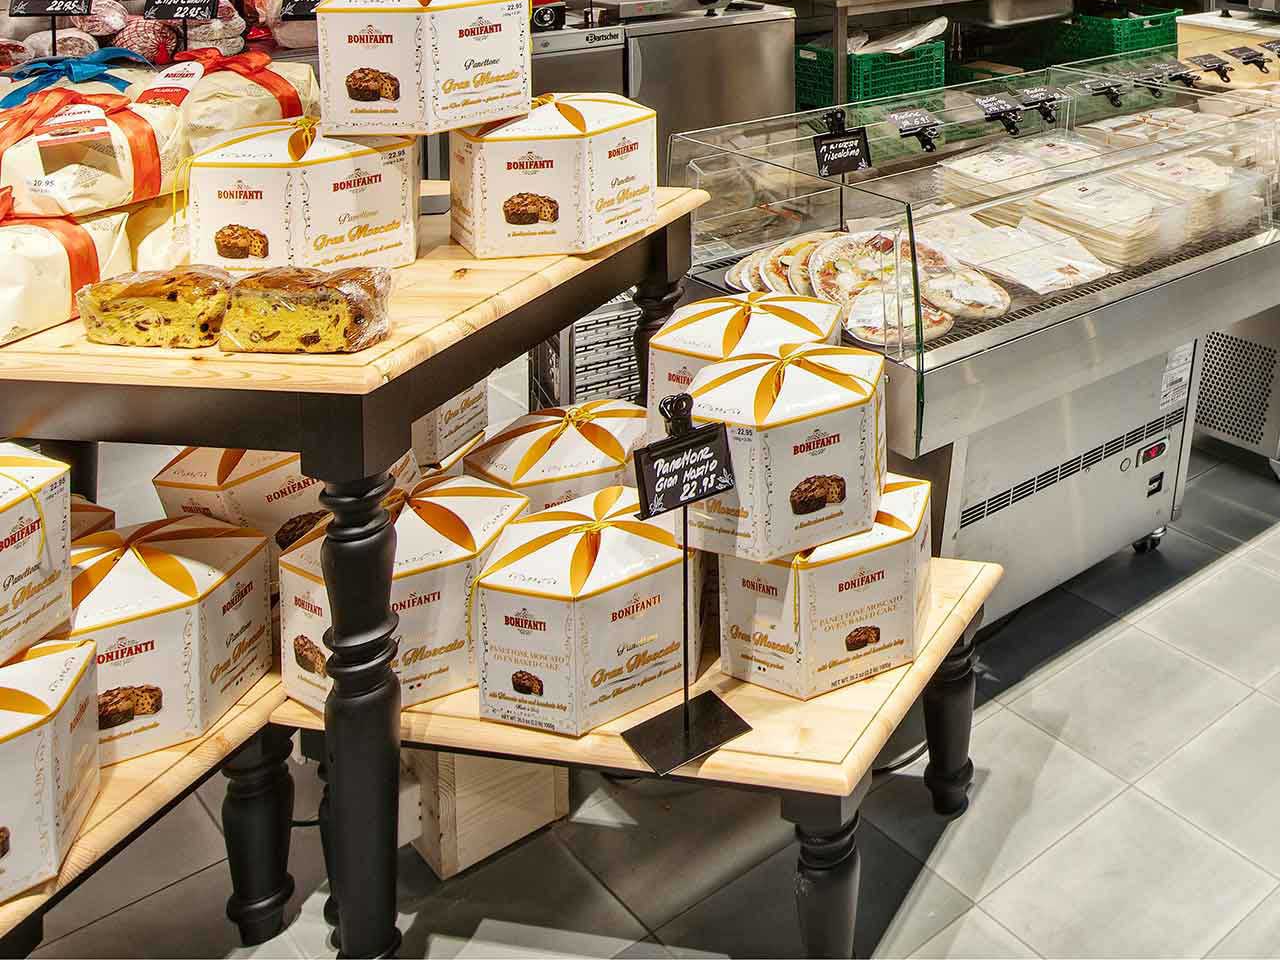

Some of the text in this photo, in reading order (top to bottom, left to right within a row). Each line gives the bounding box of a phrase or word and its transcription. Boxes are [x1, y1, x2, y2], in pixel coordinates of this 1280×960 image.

[347, 34, 393, 44] BONIFANTI
[458, 23, 502, 38] BONIFANTI
[464, 57, 501, 70] Panettone
[607, 142, 639, 159] BONIFANTI
[506, 159, 554, 171] BONIFANTI
[333, 174, 382, 192] BONIFANTI
[217, 190, 263, 200] BONIFANTI
[668, 371, 693, 386] BONIFA
[737, 428, 753, 436] 22.95
[793, 433, 840, 455] BONIFANTI
[266, 478, 318, 503] BONIFANT
[0, 519, 42, 551] BONIFANT
[742, 578, 778, 597] BONIFANTI
[838, 570, 885, 592] BONIFANTI
[222, 580, 254, 616] BONIFANTI
[294, 596, 323, 617] BONIFANTI
[392, 591, 441, 612] ONIFANTI
[611, 594, 661, 622] BONIFANTI
[504, 616, 546, 631] BONIFANTI
[97, 640, 155, 664] ONIFANTI
